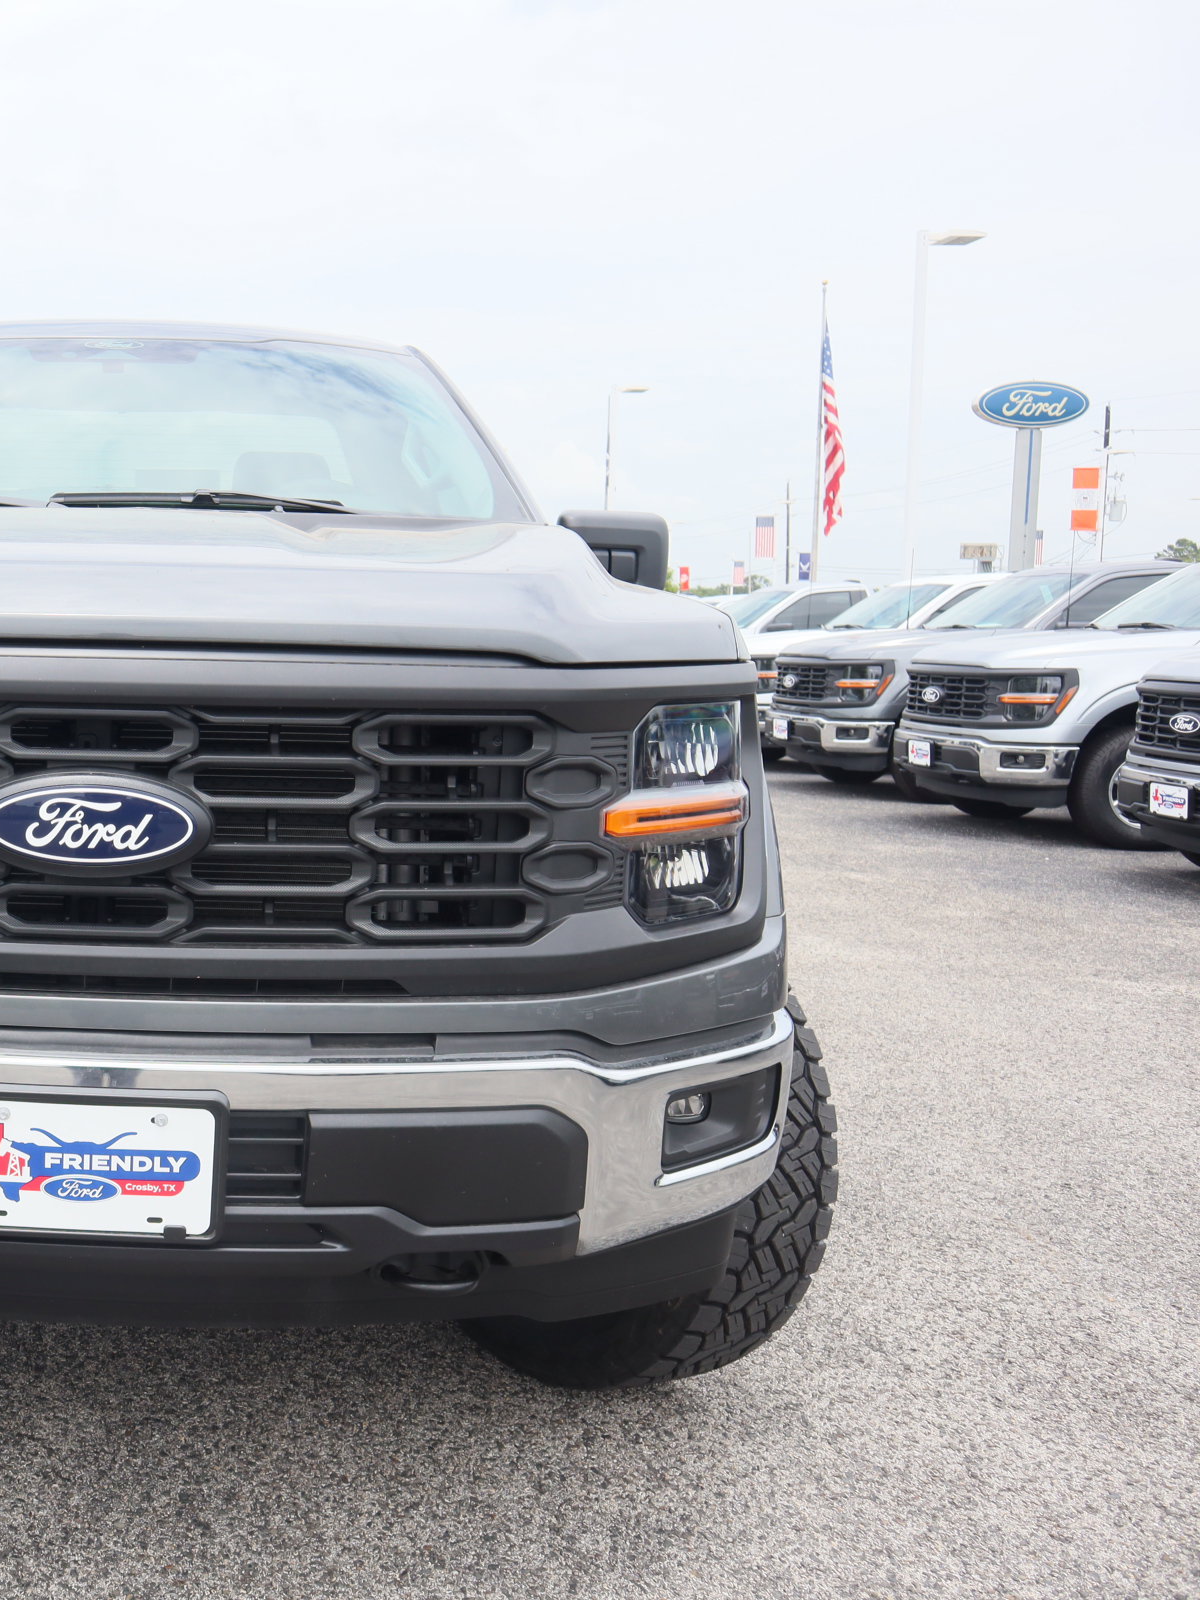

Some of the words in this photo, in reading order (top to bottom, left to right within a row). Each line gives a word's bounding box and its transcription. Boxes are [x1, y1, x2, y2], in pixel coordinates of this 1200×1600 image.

[1002, 389, 1069, 417] Ford
[25, 797, 154, 851] Ford
[44, 1152, 187, 1174] FRIENDLY
[57, 1180, 104, 1199] Ford
[125, 1183, 162, 1193] Crosby,
[163, 1184, 176, 1193] TX
